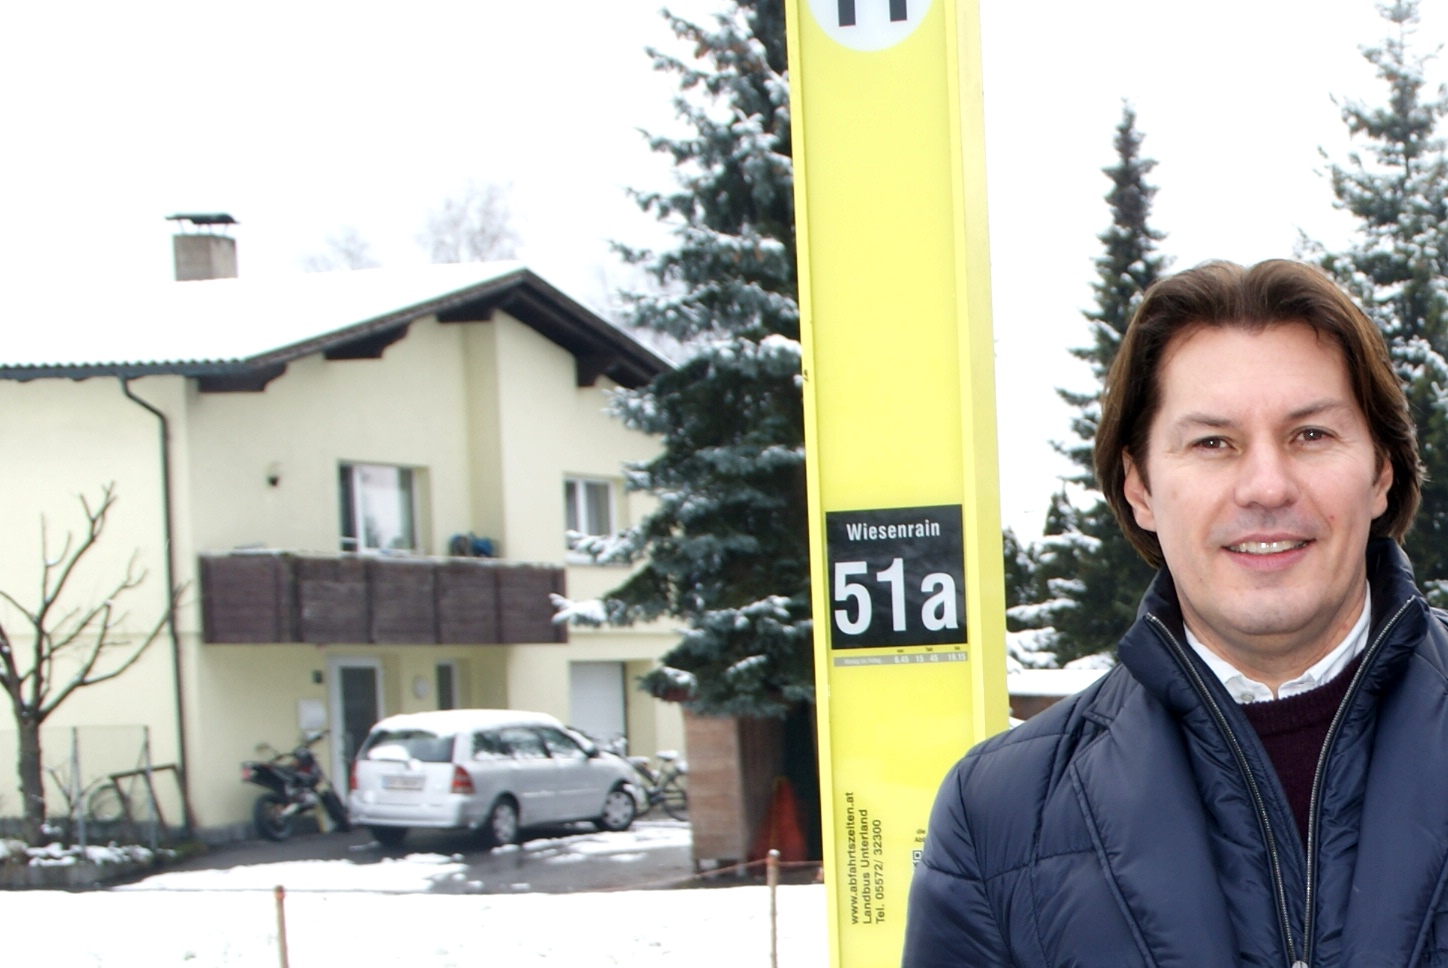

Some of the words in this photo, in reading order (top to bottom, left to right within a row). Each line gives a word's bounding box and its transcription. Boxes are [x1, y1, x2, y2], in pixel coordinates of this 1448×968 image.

[846, 520, 940, 541] Wiesenrain
[834, 557, 959, 635] 51a
[845, 792, 859, 925] www.abfahrtszeiten.at
[858, 809, 870, 869] Unterland
[872, 819, 883, 856] 32300
[861, 871, 872, 925] Landbus
[875, 904, 885, 925] Tel.
